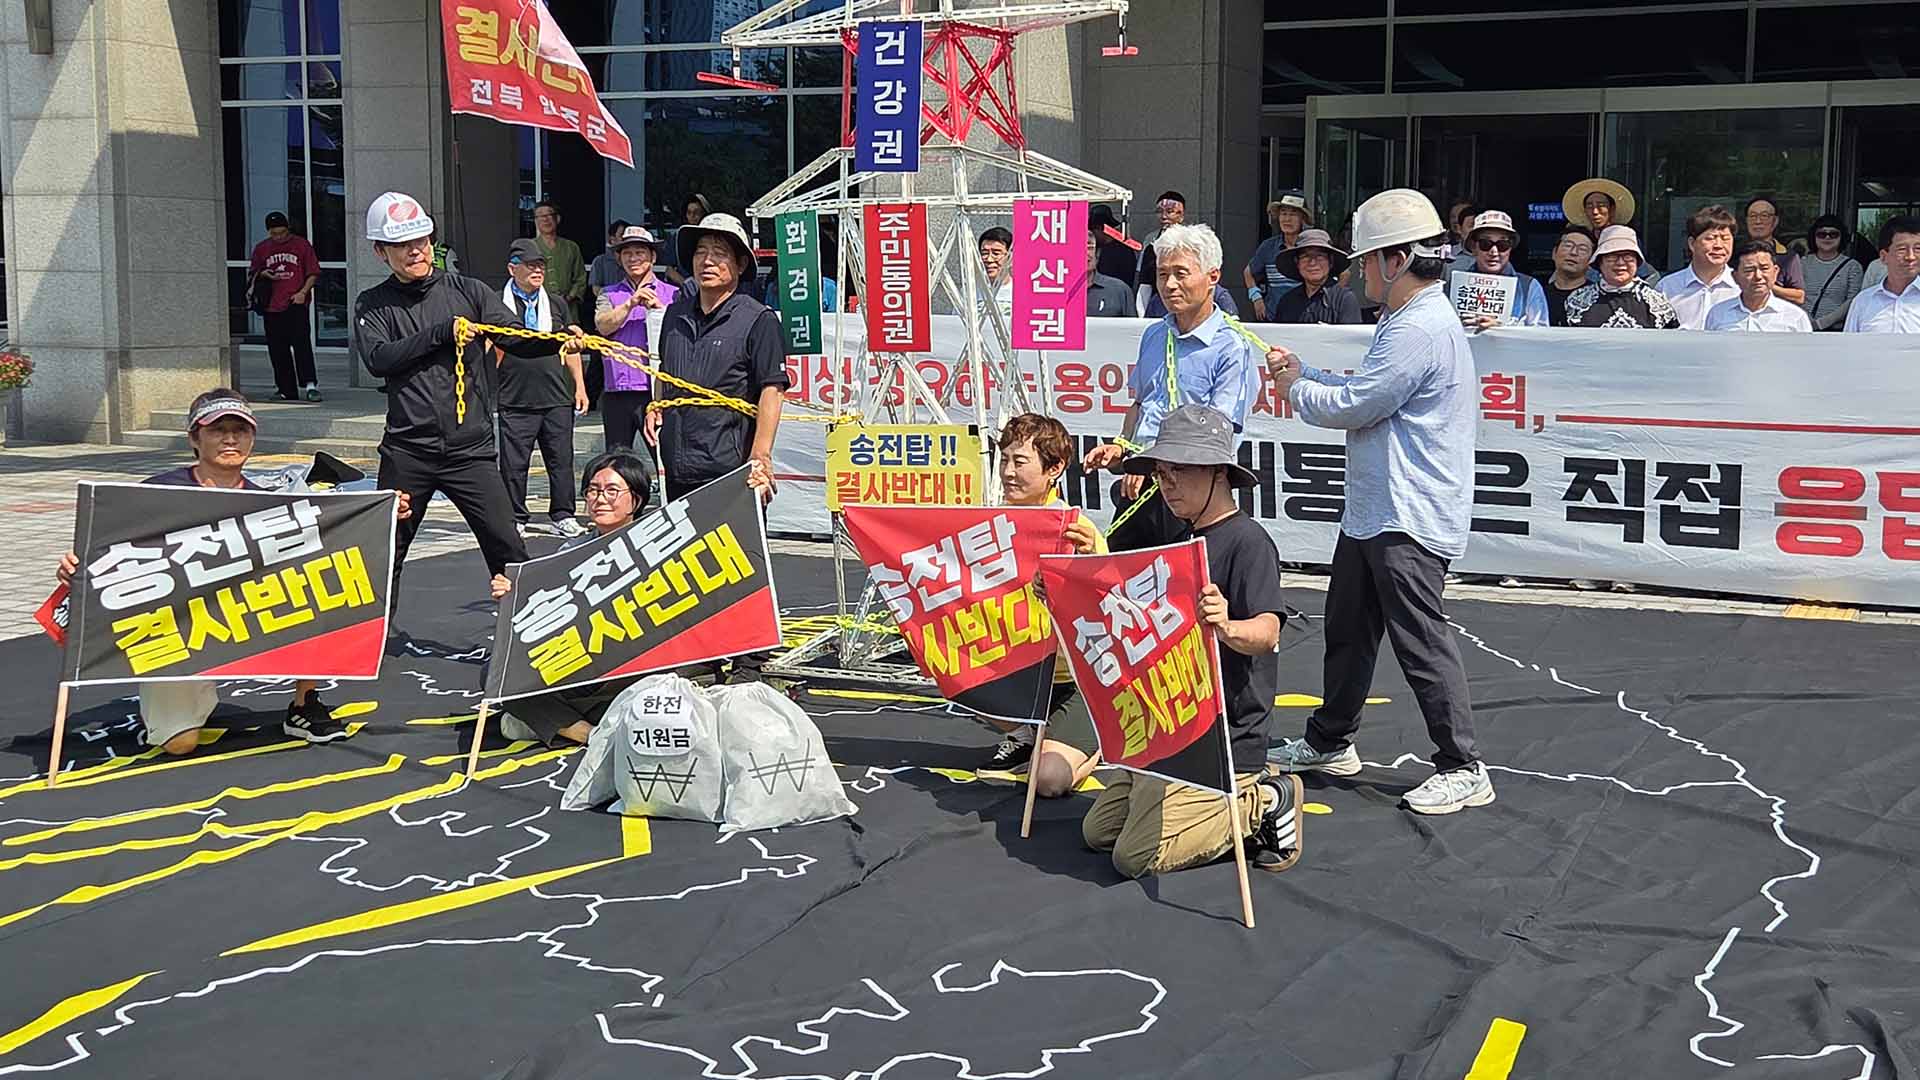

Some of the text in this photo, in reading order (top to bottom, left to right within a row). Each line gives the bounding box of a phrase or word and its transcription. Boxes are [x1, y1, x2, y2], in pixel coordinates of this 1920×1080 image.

[470, 79, 523, 110] 전북
[871, 30, 906, 164] 건강권
[784, 220, 811, 348] 환경권
[878, 212, 913, 345] 주민동의권
[1029, 209, 1069, 343] 재산권
[836, 472, 946, 504] 결사반대
[850, 433, 932, 466] 송전탑
[1562, 456, 1742, 551] 직접
[87, 499, 324, 611] 송전탑
[112, 546, 376, 675] 결사반대
[511, 499, 697, 644] 송전탑
[528, 523, 755, 686] 결사반대
[906, 583, 1052, 678] 사반대
[1072, 555, 1185, 688] 송전탑
[632, 727, 691, 749] 지원금
[642, 695, 682, 716] 한전
[1111, 623, 1213, 760] 결사반대
